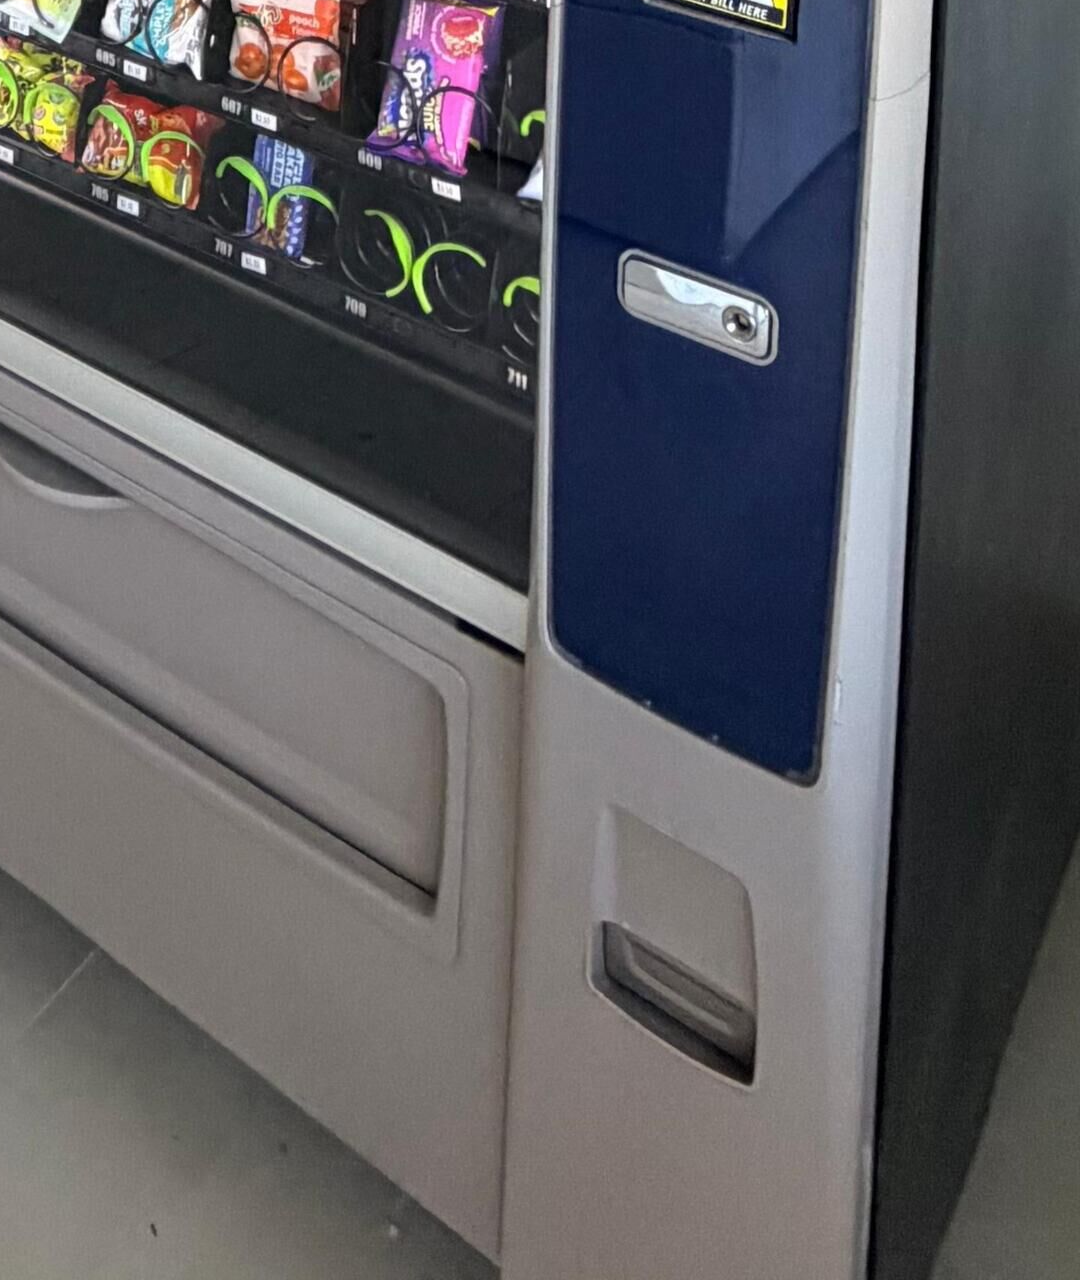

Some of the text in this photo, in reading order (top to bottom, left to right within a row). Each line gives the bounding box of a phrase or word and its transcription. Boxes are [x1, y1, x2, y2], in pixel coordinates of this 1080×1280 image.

[738, 1, 768, 21] HERE
[221, 96, 241, 115] 607
[423, 95, 436, 132] JUIC
[508, 366, 527, 391] 711
